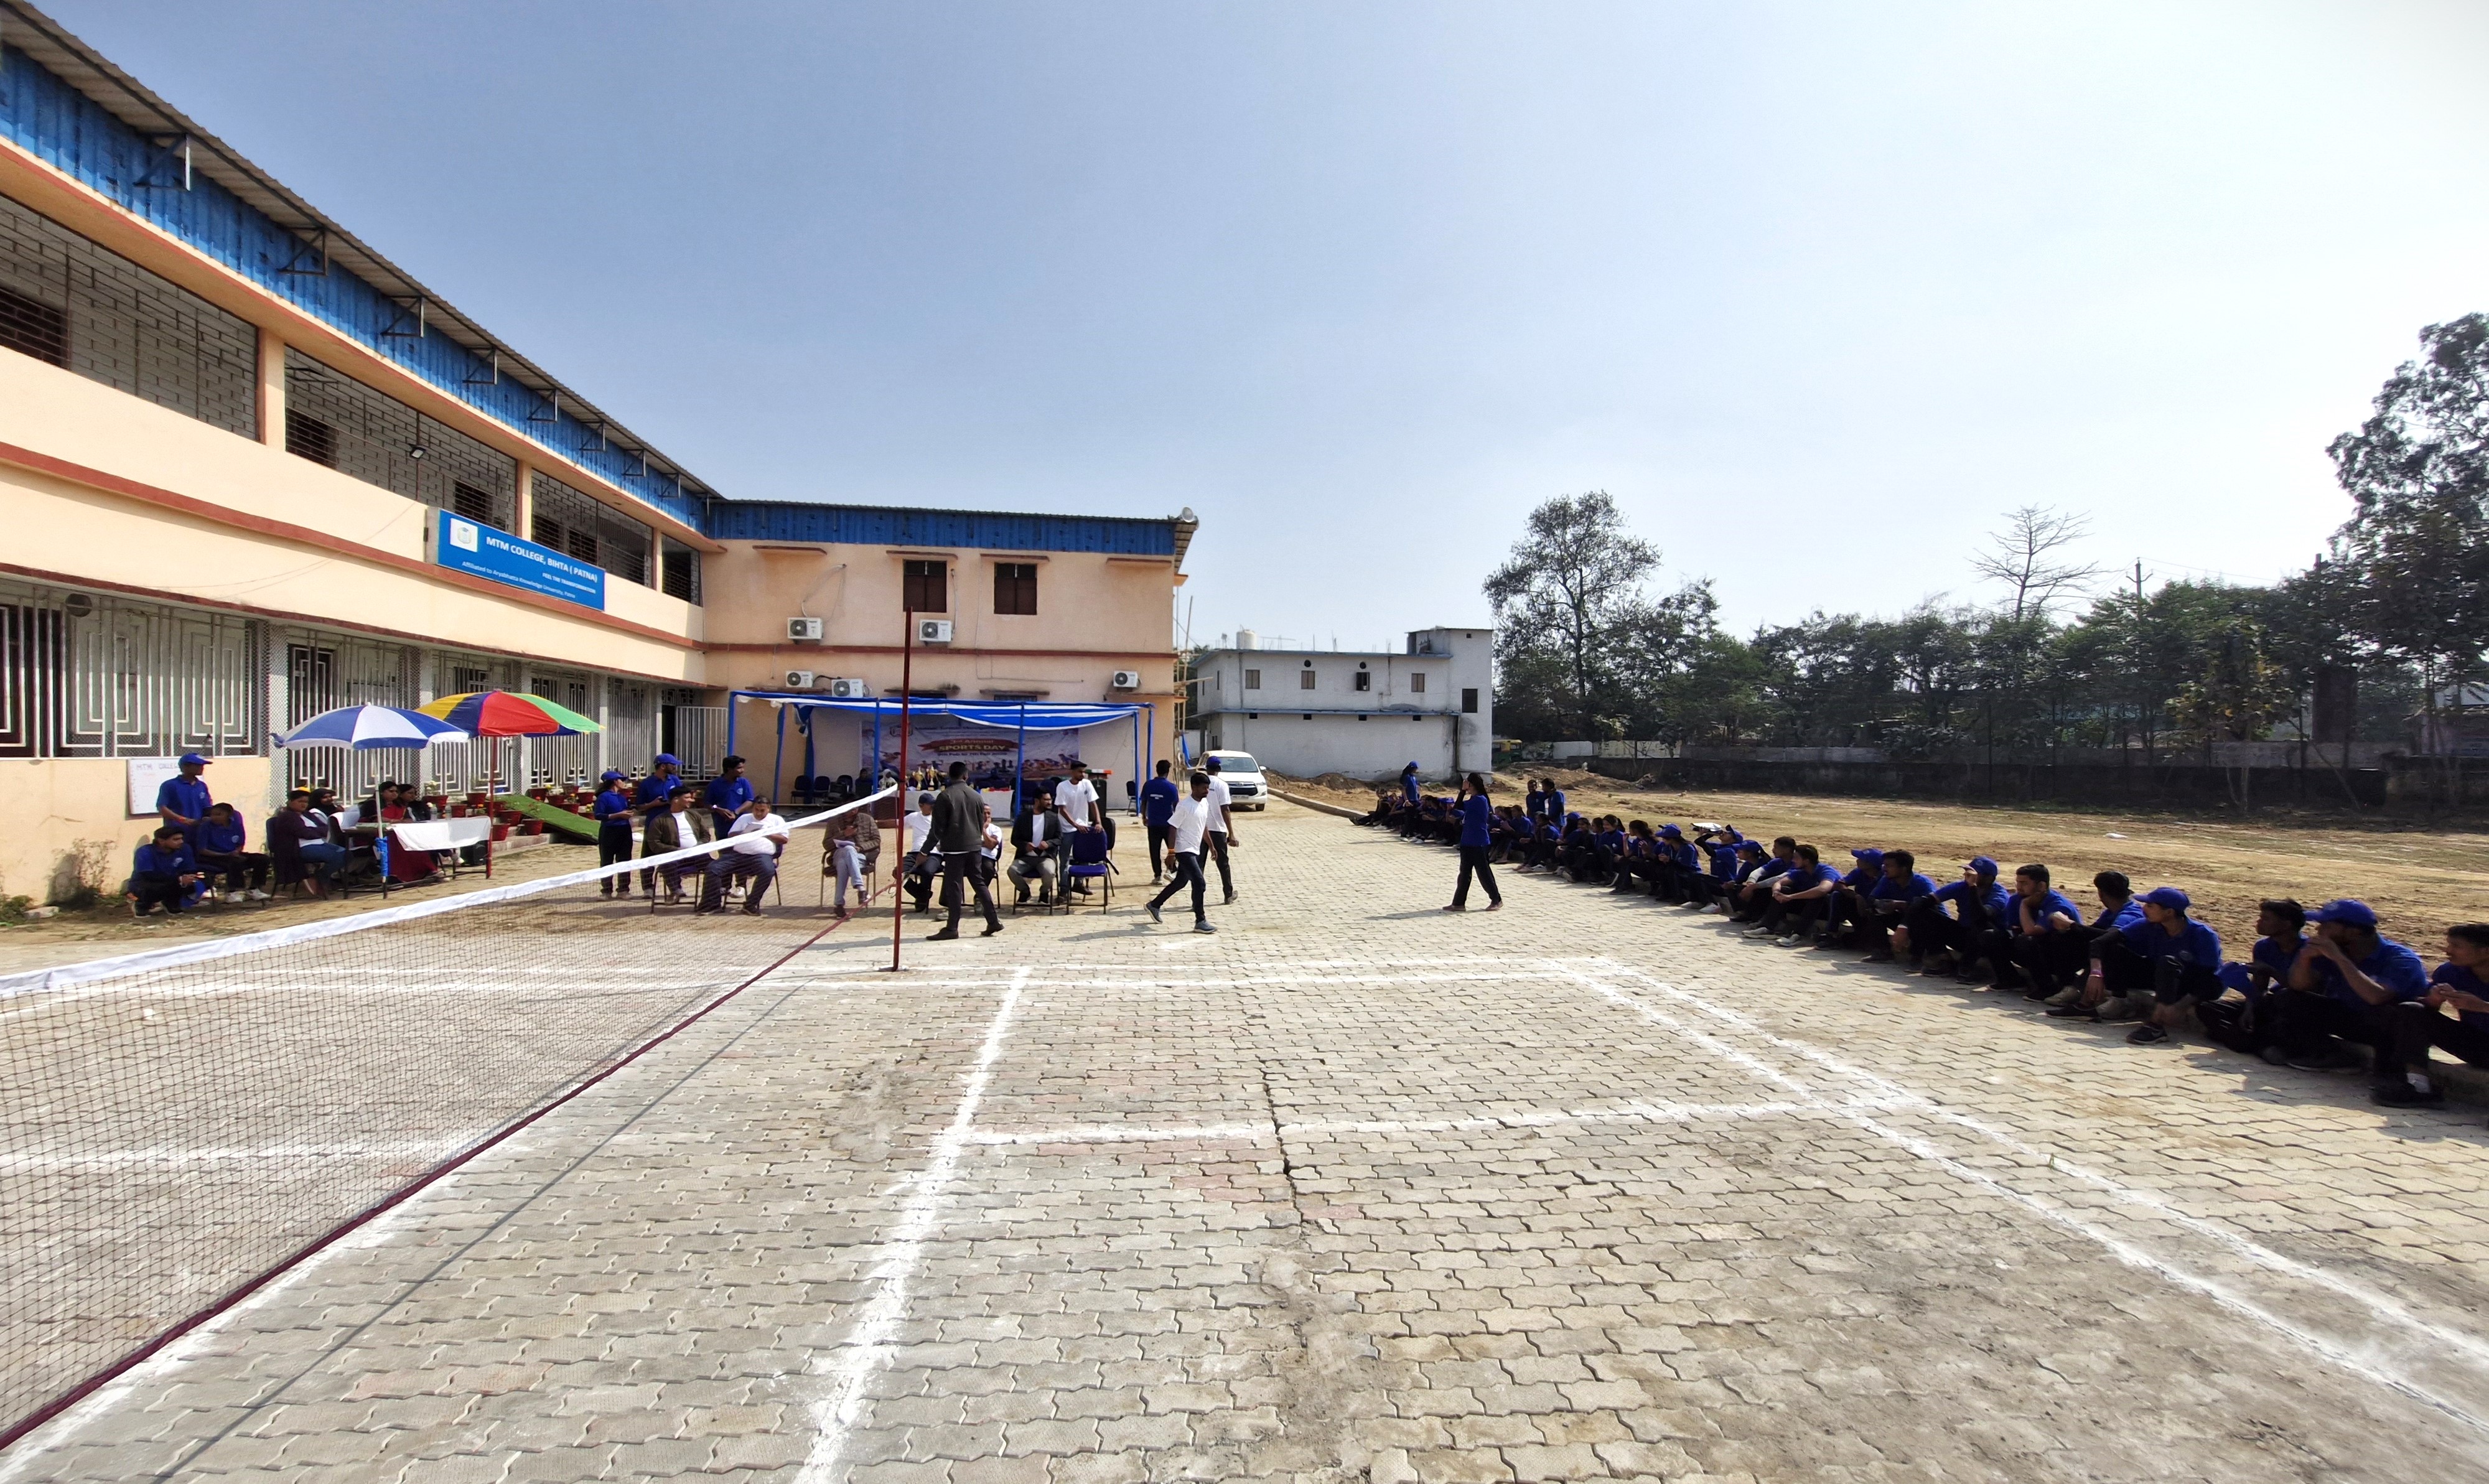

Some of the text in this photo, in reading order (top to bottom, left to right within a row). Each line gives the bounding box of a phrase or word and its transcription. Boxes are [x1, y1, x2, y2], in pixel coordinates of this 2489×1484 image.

[487, 536, 509, 551] MTM
[511, 545, 546, 565] COLLEGE,
[548, 558, 569, 572] BIHTA
